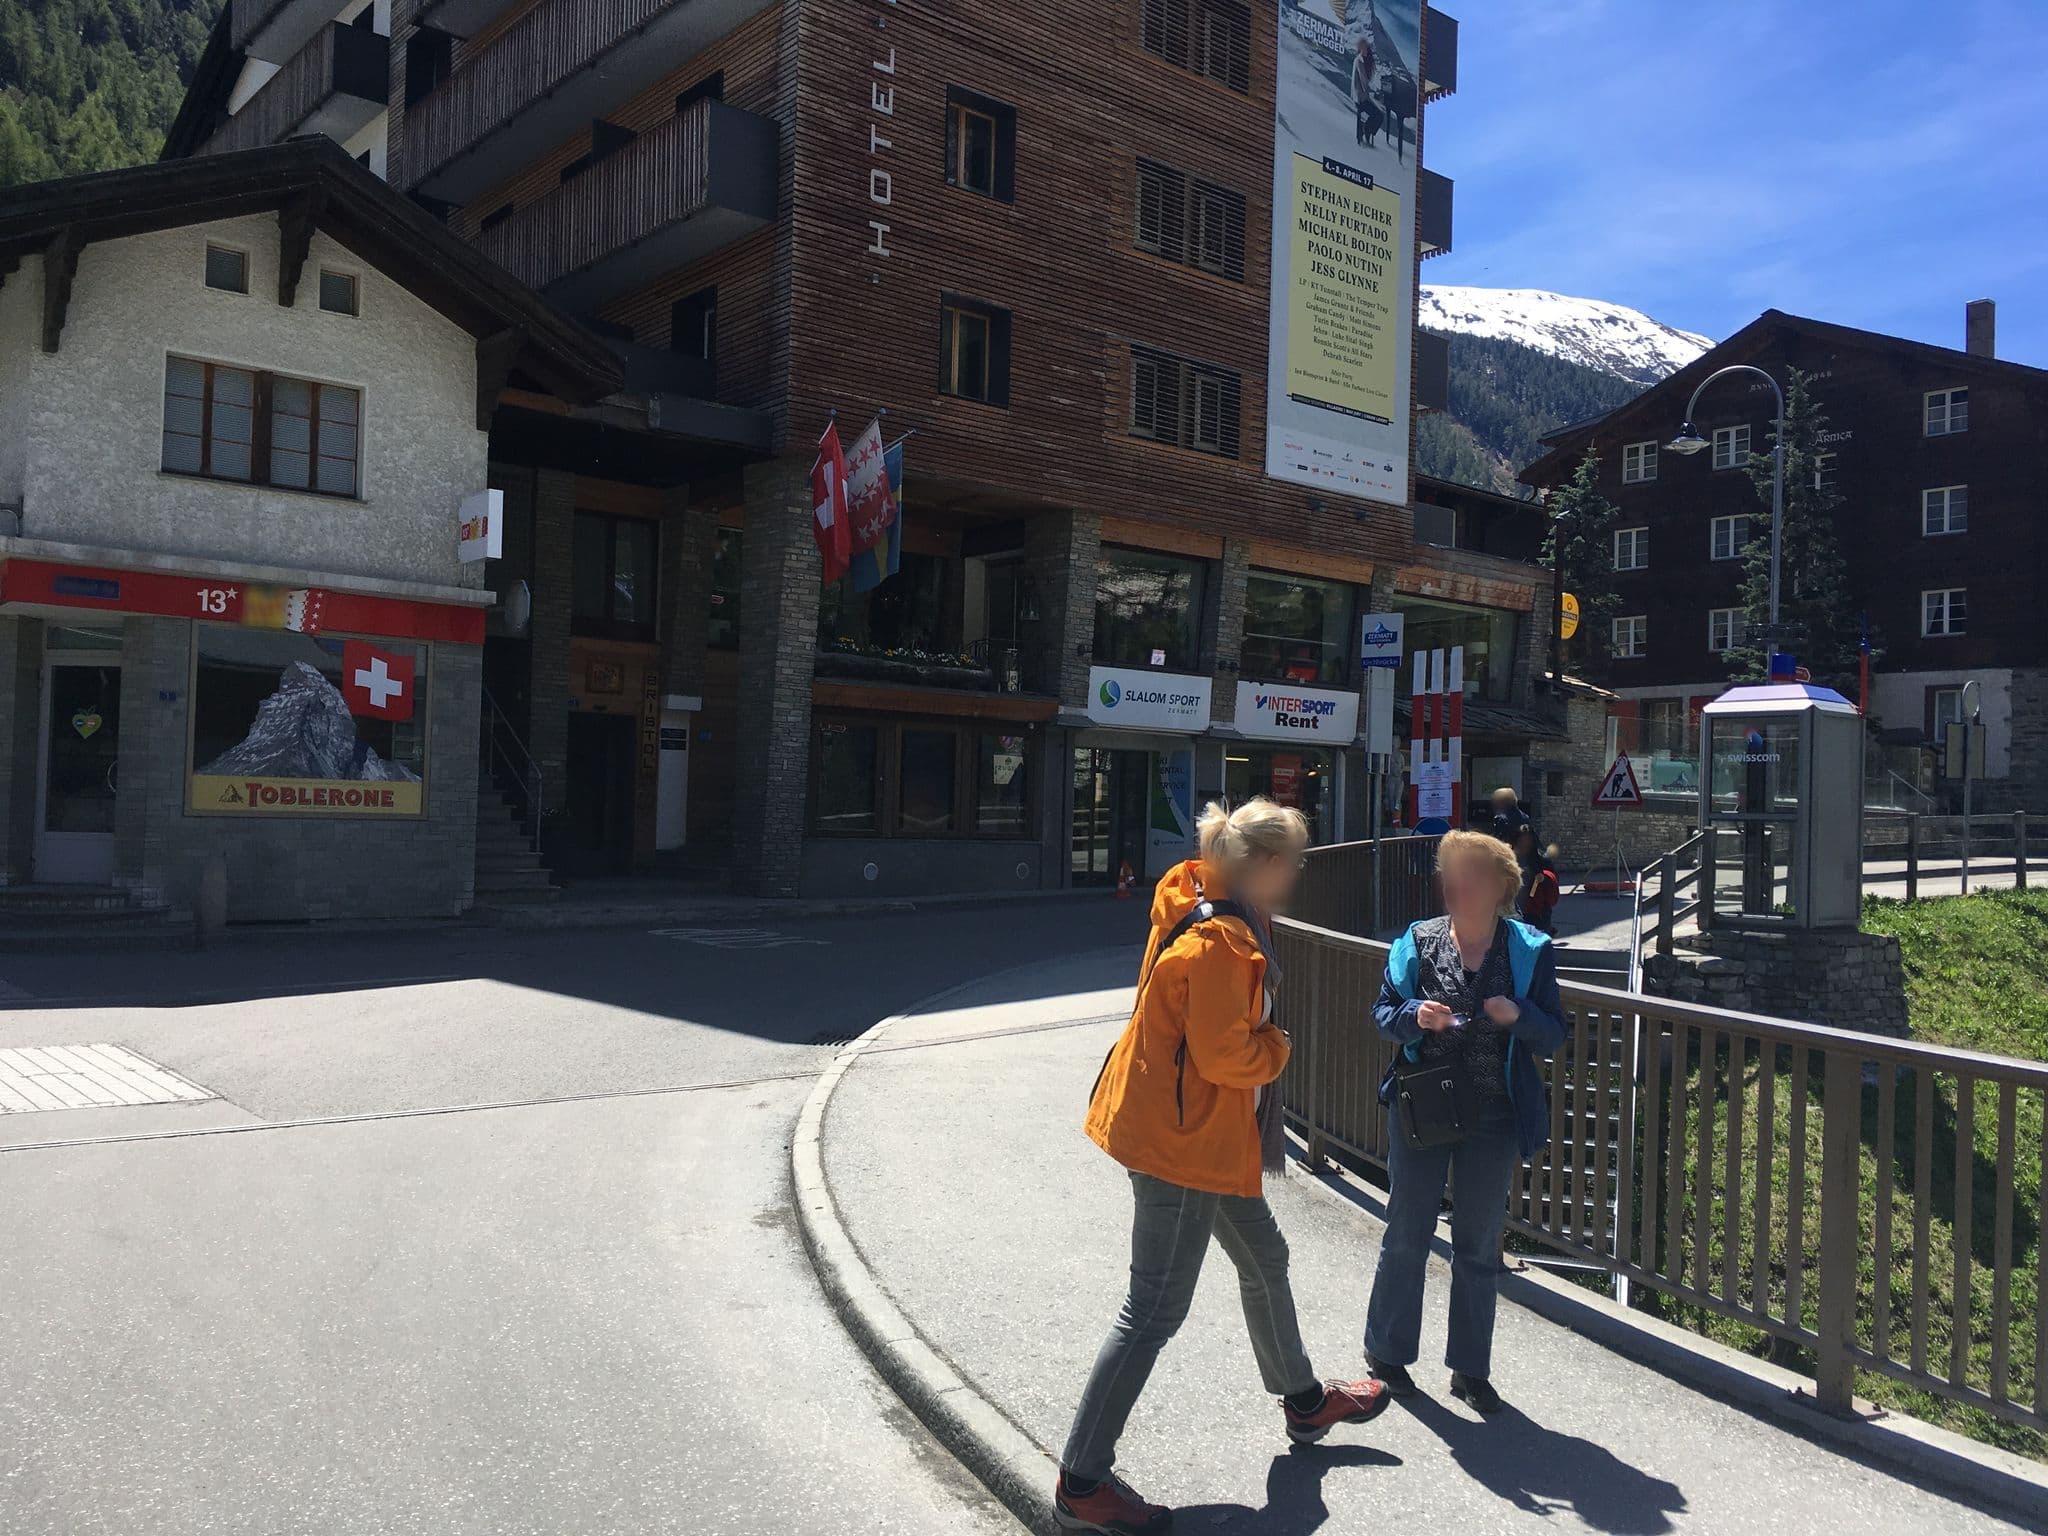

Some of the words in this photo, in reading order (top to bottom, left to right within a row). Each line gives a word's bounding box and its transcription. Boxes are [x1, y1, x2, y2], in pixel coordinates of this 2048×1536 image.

[1296, 25, 1345, 54] UNPLUGGED
[1297, 12, 1344, 43] ZERMATT
[868, 48, 895, 257] HOTEL
[1343, 168, 1362, 183] APRIL
[1363, 176, 1372, 186] 17
[1301, 181, 1350, 209] STEPHAN
[1353, 201, 1392, 226] EICHER
[1304, 201, 1337, 223] NELLY
[1340, 215, 1388, 242] FURTADO
[1299, 218, 1348, 246] MICHAEL
[1351, 237, 1392, 263] BOLTON
[1308, 240, 1342, 262] PAOLO
[1345, 253, 1382, 276] NUTINI
[1311, 260, 1335, 278] JESS
[1338, 269, 1379, 293] GLYNNE
[1125, 690, 1167, 704] SLALOM
[1168, 694, 1201, 707] SPORT
[1267, 696, 1336, 715] INTERSPORT
[1275, 712, 1320, 729] Rent
[1728, 752, 1780, 763] swisscom
[246, 782, 394, 807] TOBLERONE
